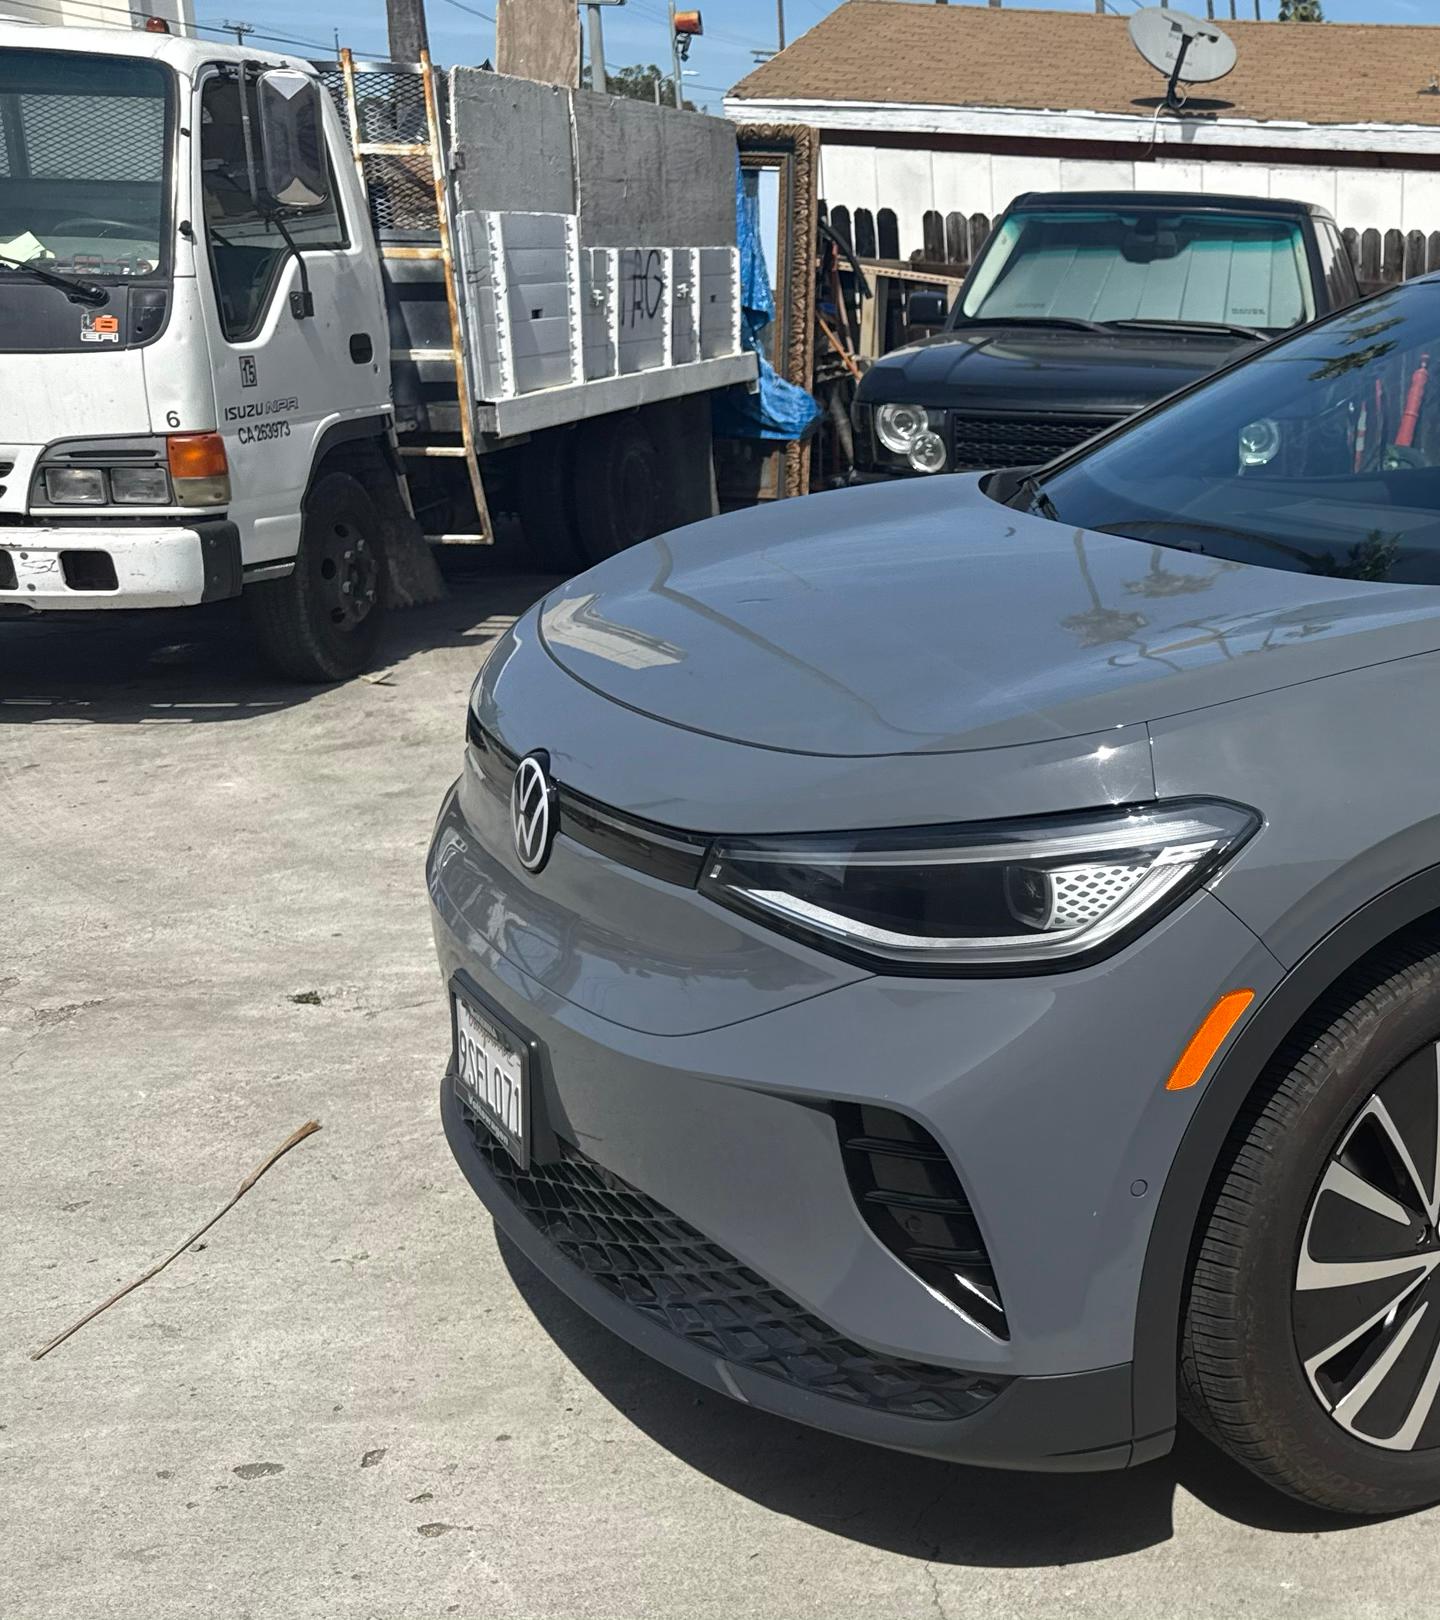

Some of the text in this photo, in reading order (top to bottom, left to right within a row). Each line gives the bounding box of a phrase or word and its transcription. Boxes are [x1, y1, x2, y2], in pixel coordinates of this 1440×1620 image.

[166, 410, 181, 428] 6
[224, 396, 299, 421] ISUZU NPR
[459, 1030, 521, 1136] 9SFL071
[468, 1093, 510, 1146] Volkswagen
